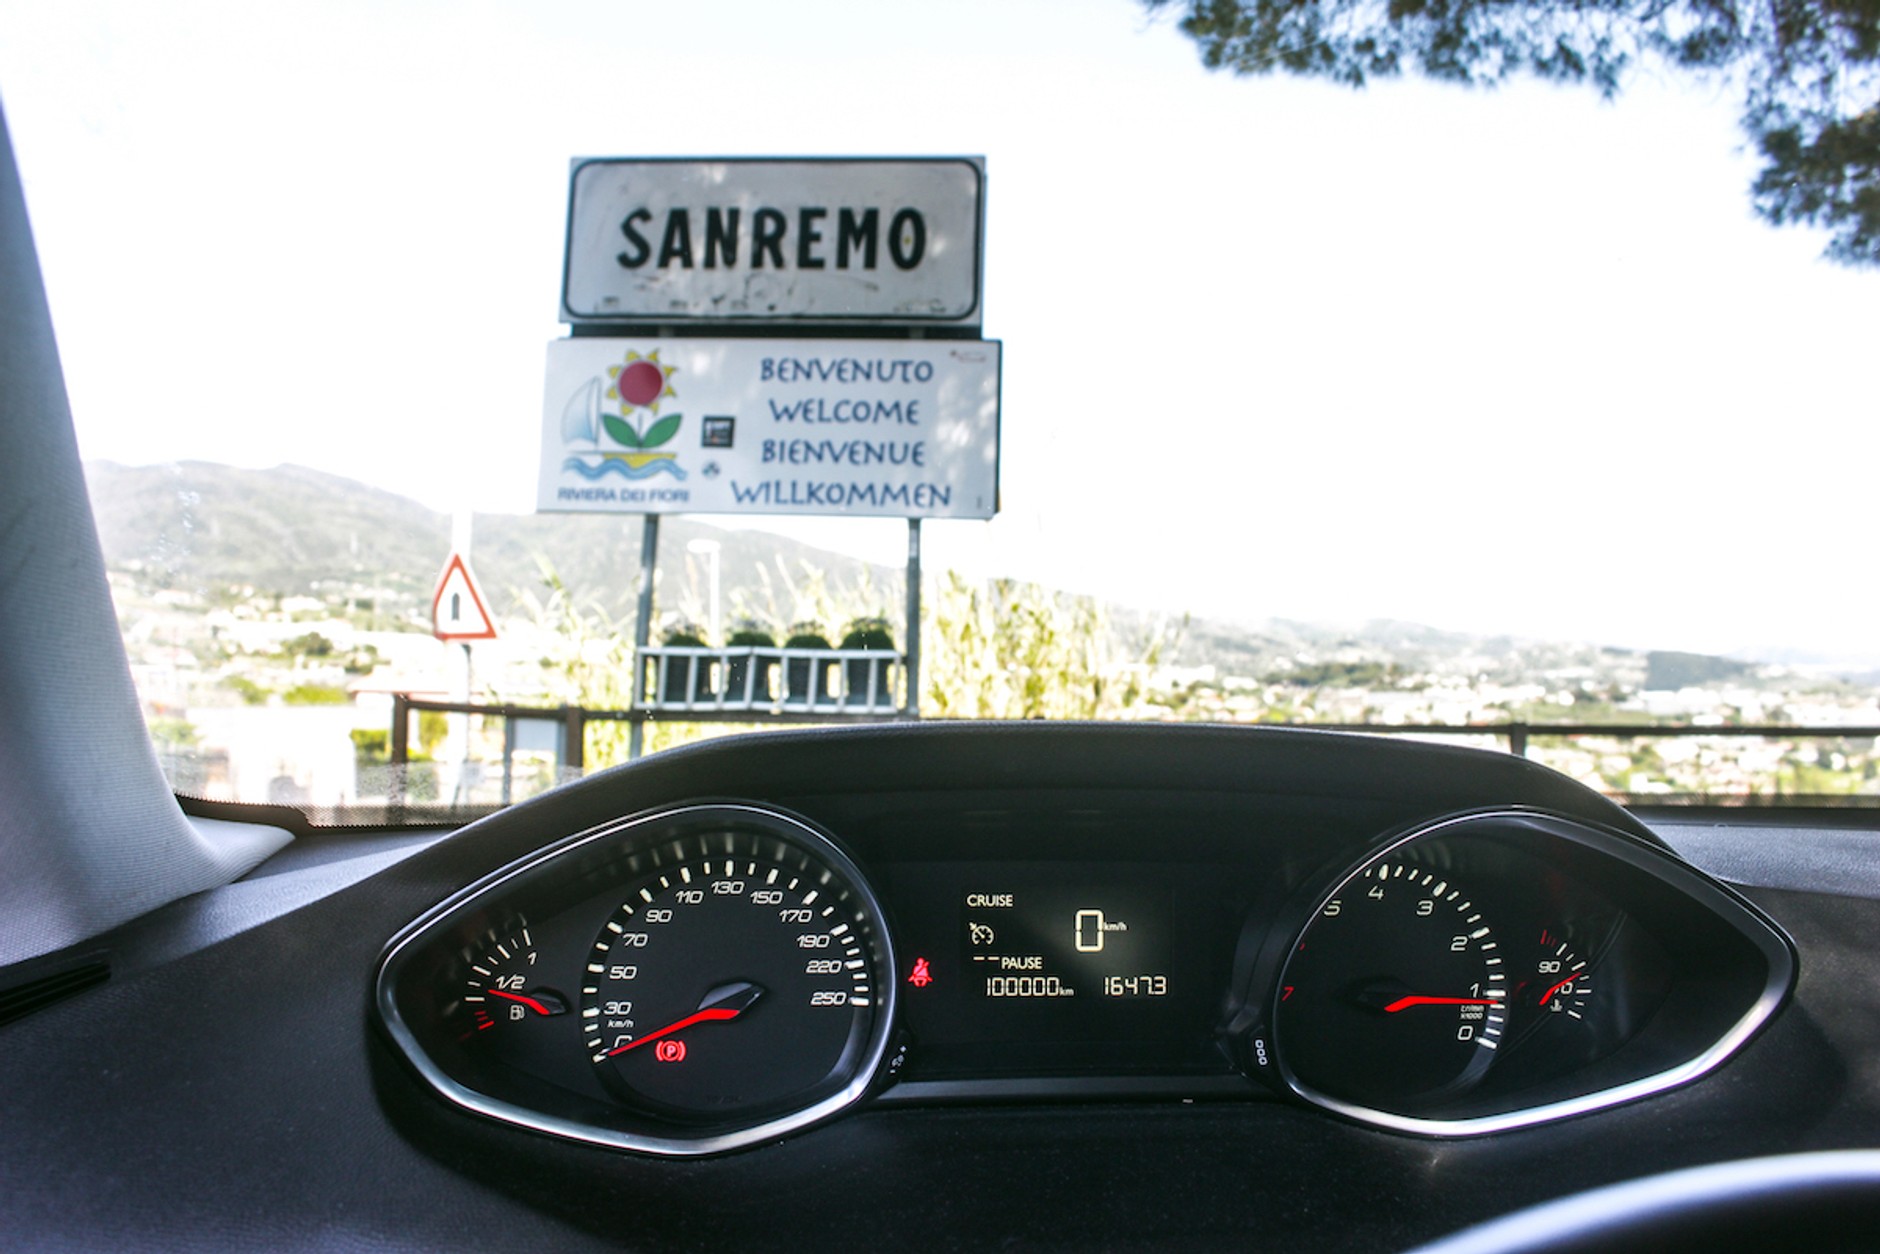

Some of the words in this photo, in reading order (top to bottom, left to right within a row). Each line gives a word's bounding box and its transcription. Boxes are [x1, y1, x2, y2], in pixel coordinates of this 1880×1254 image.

[616, 206, 928, 270] SANREMO
[760, 356, 934, 384] BENVENUTO
[768, 398, 920, 425] WELCOME
[762, 439, 925, 466] BIENVENUE
[557, 486, 616, 501] RIVIERA
[619, 488, 645, 502] DEI
[648, 488, 690, 503] FIORI
[730, 480, 952, 508] WILLKOMMEN
[711, 880, 743, 895] 130
[1368, 885, 1384, 900] 4
[676, 889, 703, 904] 110
[750, 890, 782, 905] 150
[966, 894, 1013, 907] CRUISE
[645, 908, 672, 923] 90
[778, 908, 812, 923] 170
[1324, 900, 1341, 916] 5
[1416, 900, 1433, 916] 3
[1075, 909, 1104, 952] 0
[1104, 922, 1127, 931] km/h
[622, 932, 649, 947] 70
[796, 934, 830, 949] 190
[1450, 935, 1468, 951] 2
[528, 951, 537, 965] 1
[1001, 957, 1043, 969] PAUSE
[609, 965, 637, 980] 50
[805, 959, 842, 974] 220
[1539, 961, 1561, 973] 90
[496, 974, 526, 989] 1/2
[986, 977, 1059, 996] 100000
[1060, 986, 1074, 996] km
[1282, 986, 1294, 1001] 7
[1470, 983, 1479, 998] 1
[810, 991, 846, 1006] 250
[603, 1001, 632, 1015] 30
[607, 1020, 634, 1028] km/h
[1457, 1025, 1473, 1041] 0
